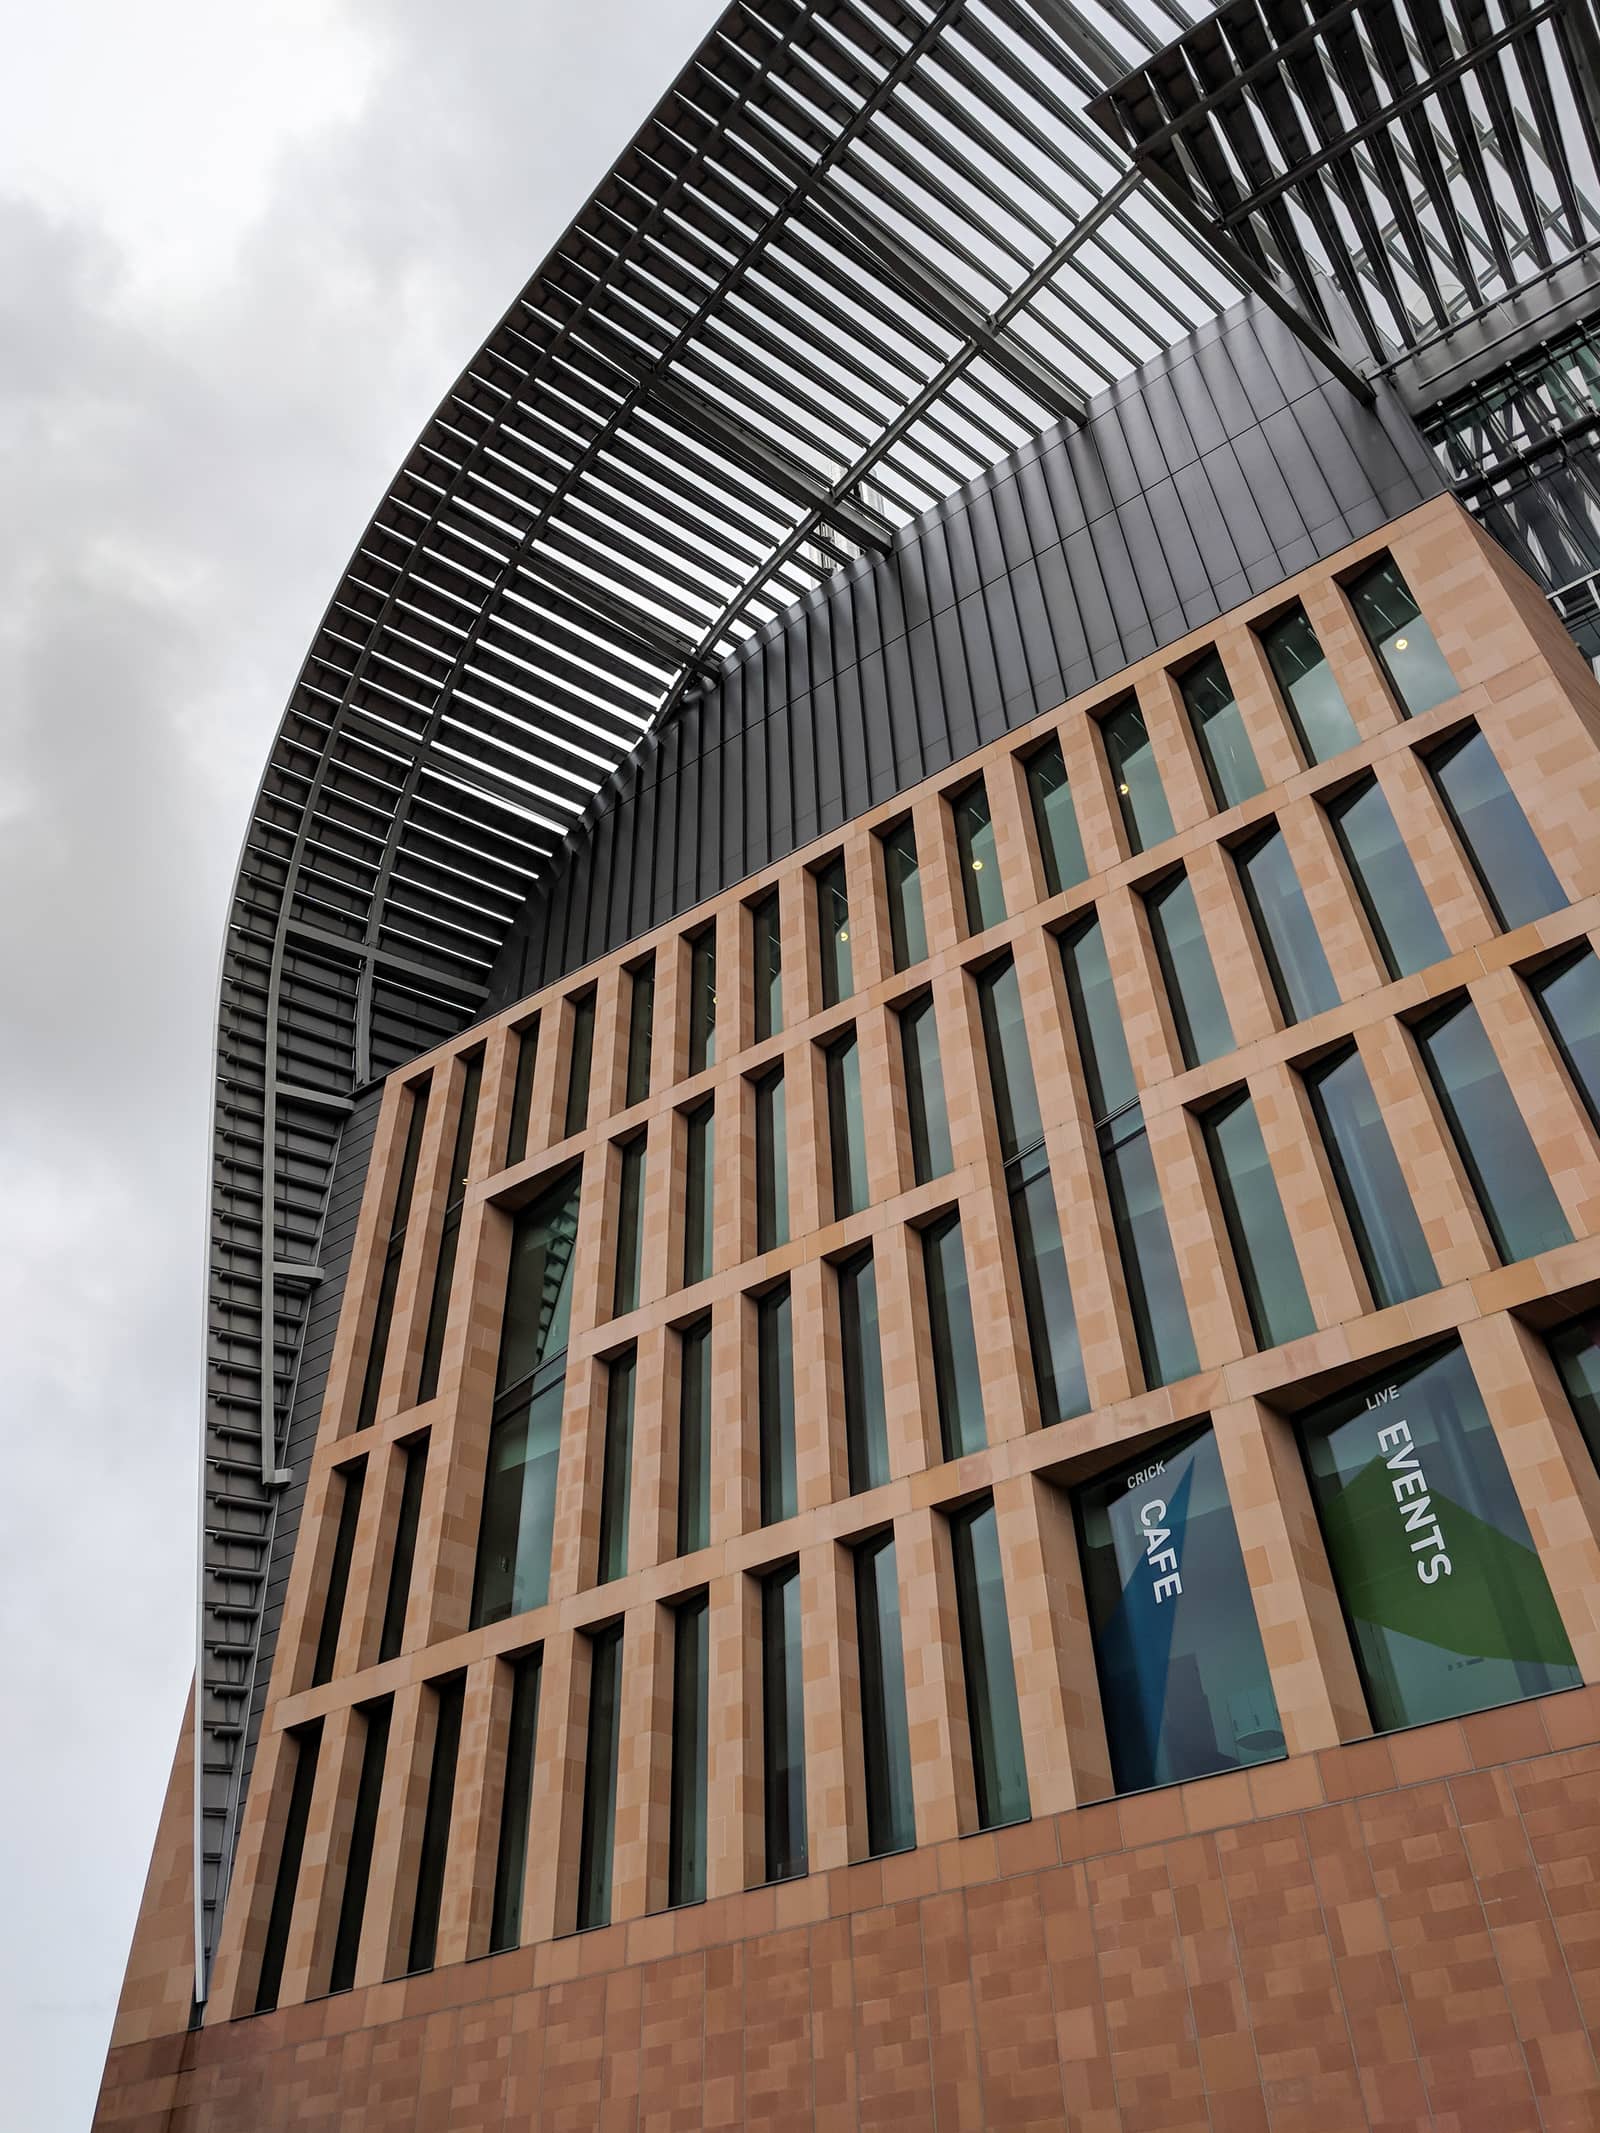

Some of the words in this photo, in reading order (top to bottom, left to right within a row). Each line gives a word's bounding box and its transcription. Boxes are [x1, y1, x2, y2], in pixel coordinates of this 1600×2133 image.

[1366, 1385, 1400, 1411] LIVE
[1127, 1460, 1167, 1489] CRICK
[1377, 1419, 1452, 1585] EVENTS
[1140, 1499, 1183, 1604] CAFE
